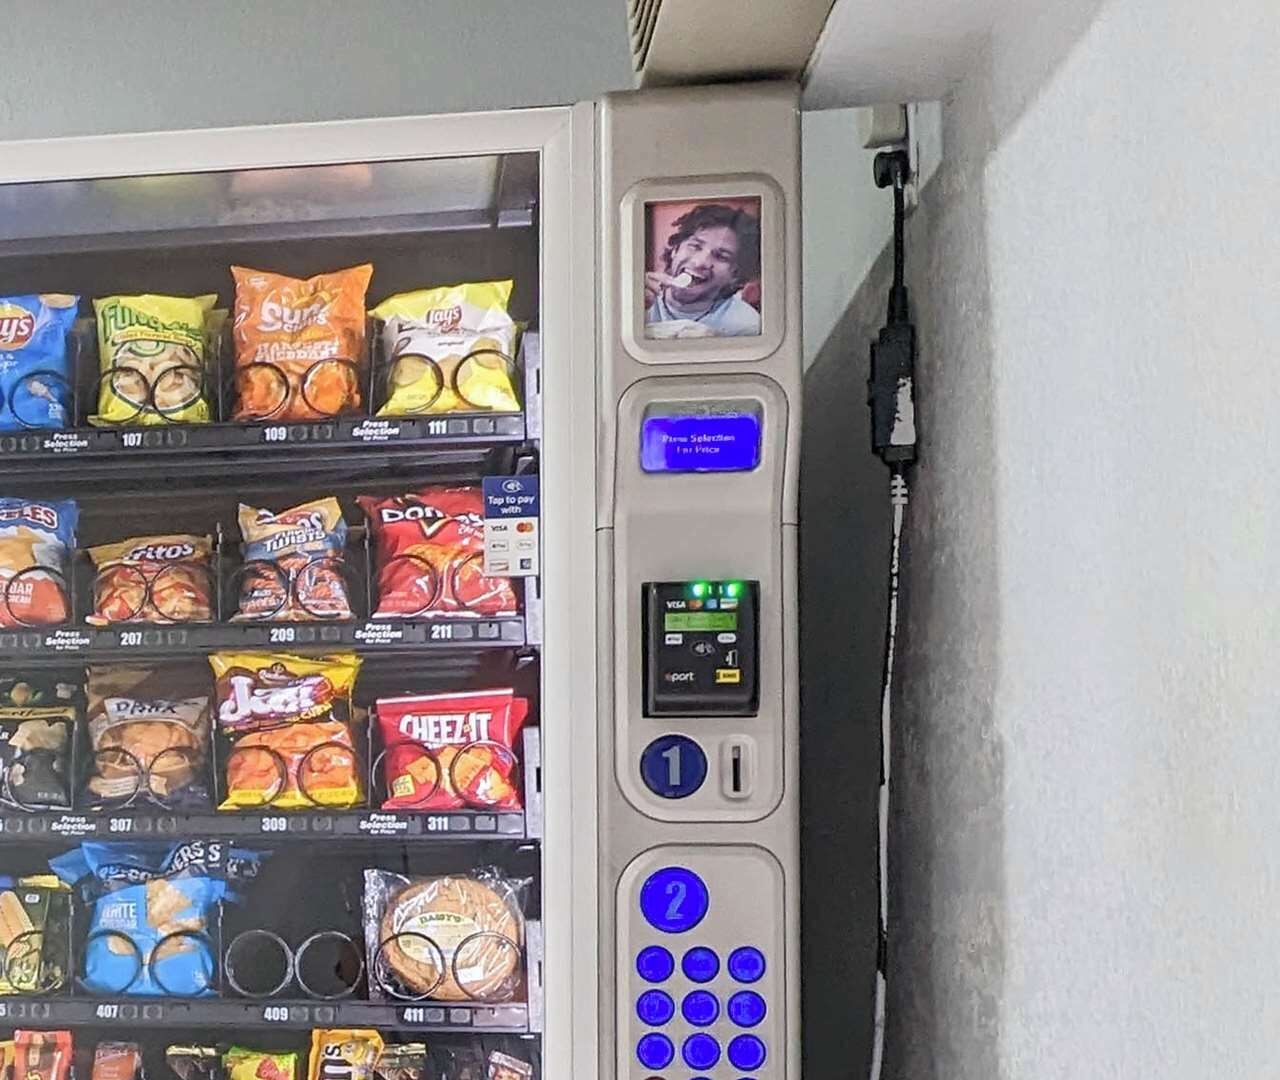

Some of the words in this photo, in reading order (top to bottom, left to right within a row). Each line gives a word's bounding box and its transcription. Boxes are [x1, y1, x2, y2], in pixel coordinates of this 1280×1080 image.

[264, 427, 287, 441] 109
[428, 420, 448, 435] 111
[122, 433, 142, 447] 107
[487, 496, 504, 506] Tap
[506, 496, 516, 504] to
[517, 496, 535, 505] pay
[500, 506, 522, 514] with
[666, 601, 686, 609] VISA
[121, 632, 142, 645] 207
[270, 629, 294, 642] 209
[431, 625, 452, 639] 211
[662, 745, 681, 786] 1
[110, 818, 132, 832] 307
[262, 817, 287, 831] 309
[428, 817, 449, 831] 311
[664, 880, 687, 920] 2
[96, 1005, 119, 1018] 407
[264, 1007, 288, 1020] 409
[403, 1007, 424, 1022] 411
